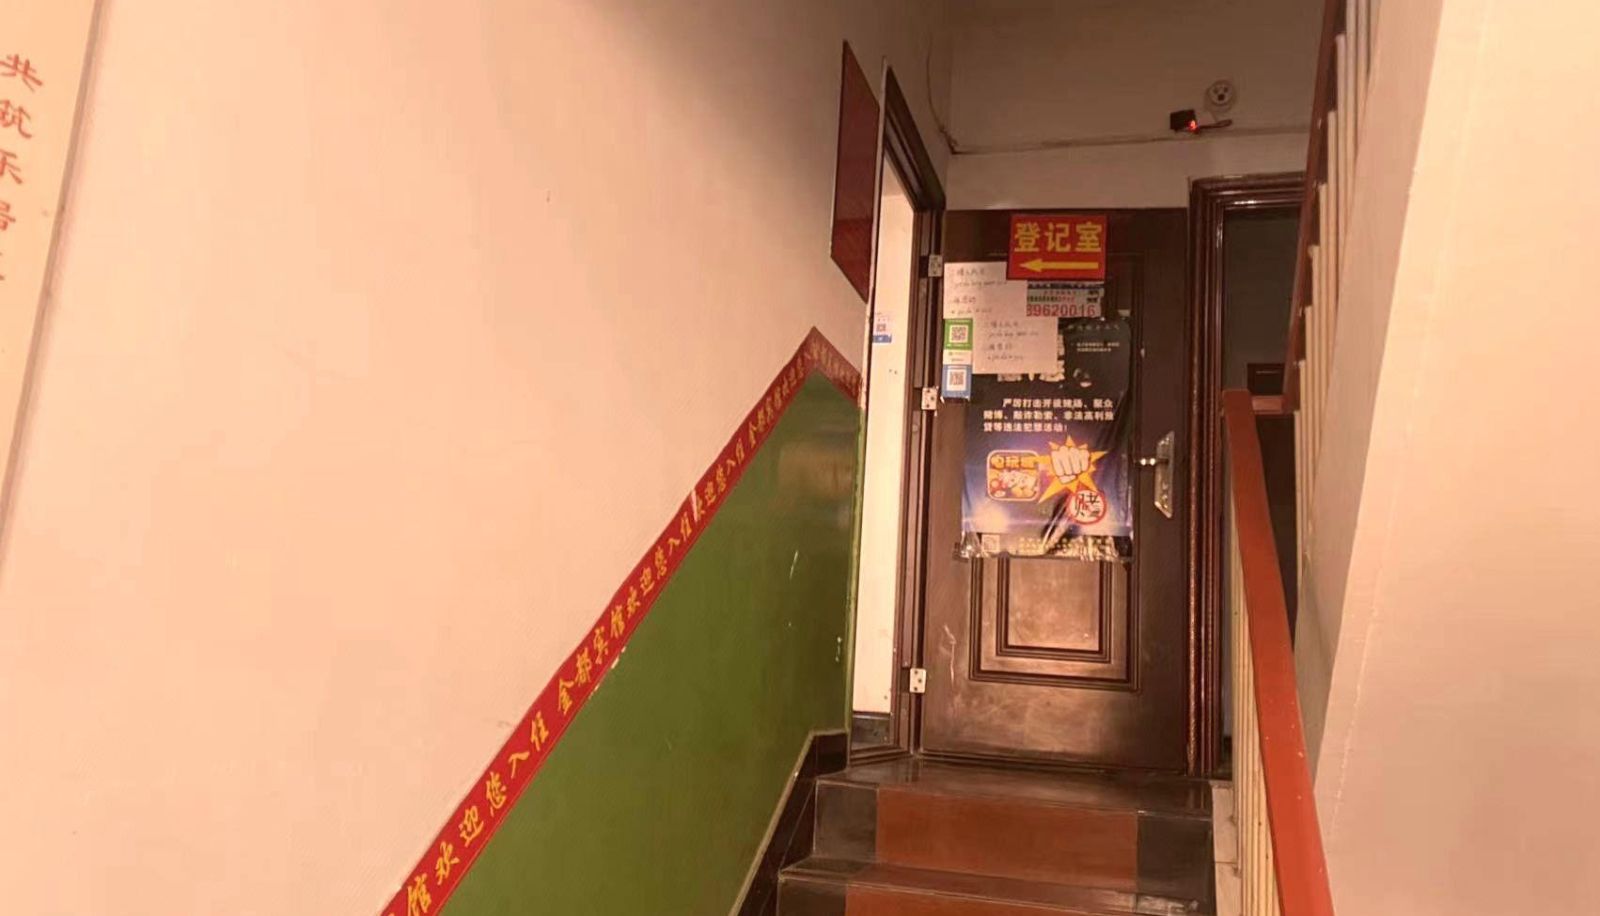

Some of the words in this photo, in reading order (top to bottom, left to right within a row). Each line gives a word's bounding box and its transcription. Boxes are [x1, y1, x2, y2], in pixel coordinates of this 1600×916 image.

[1014, 221, 1102, 253] 登记室
[387, 710, 550, 916] 馆欢迎您入住
